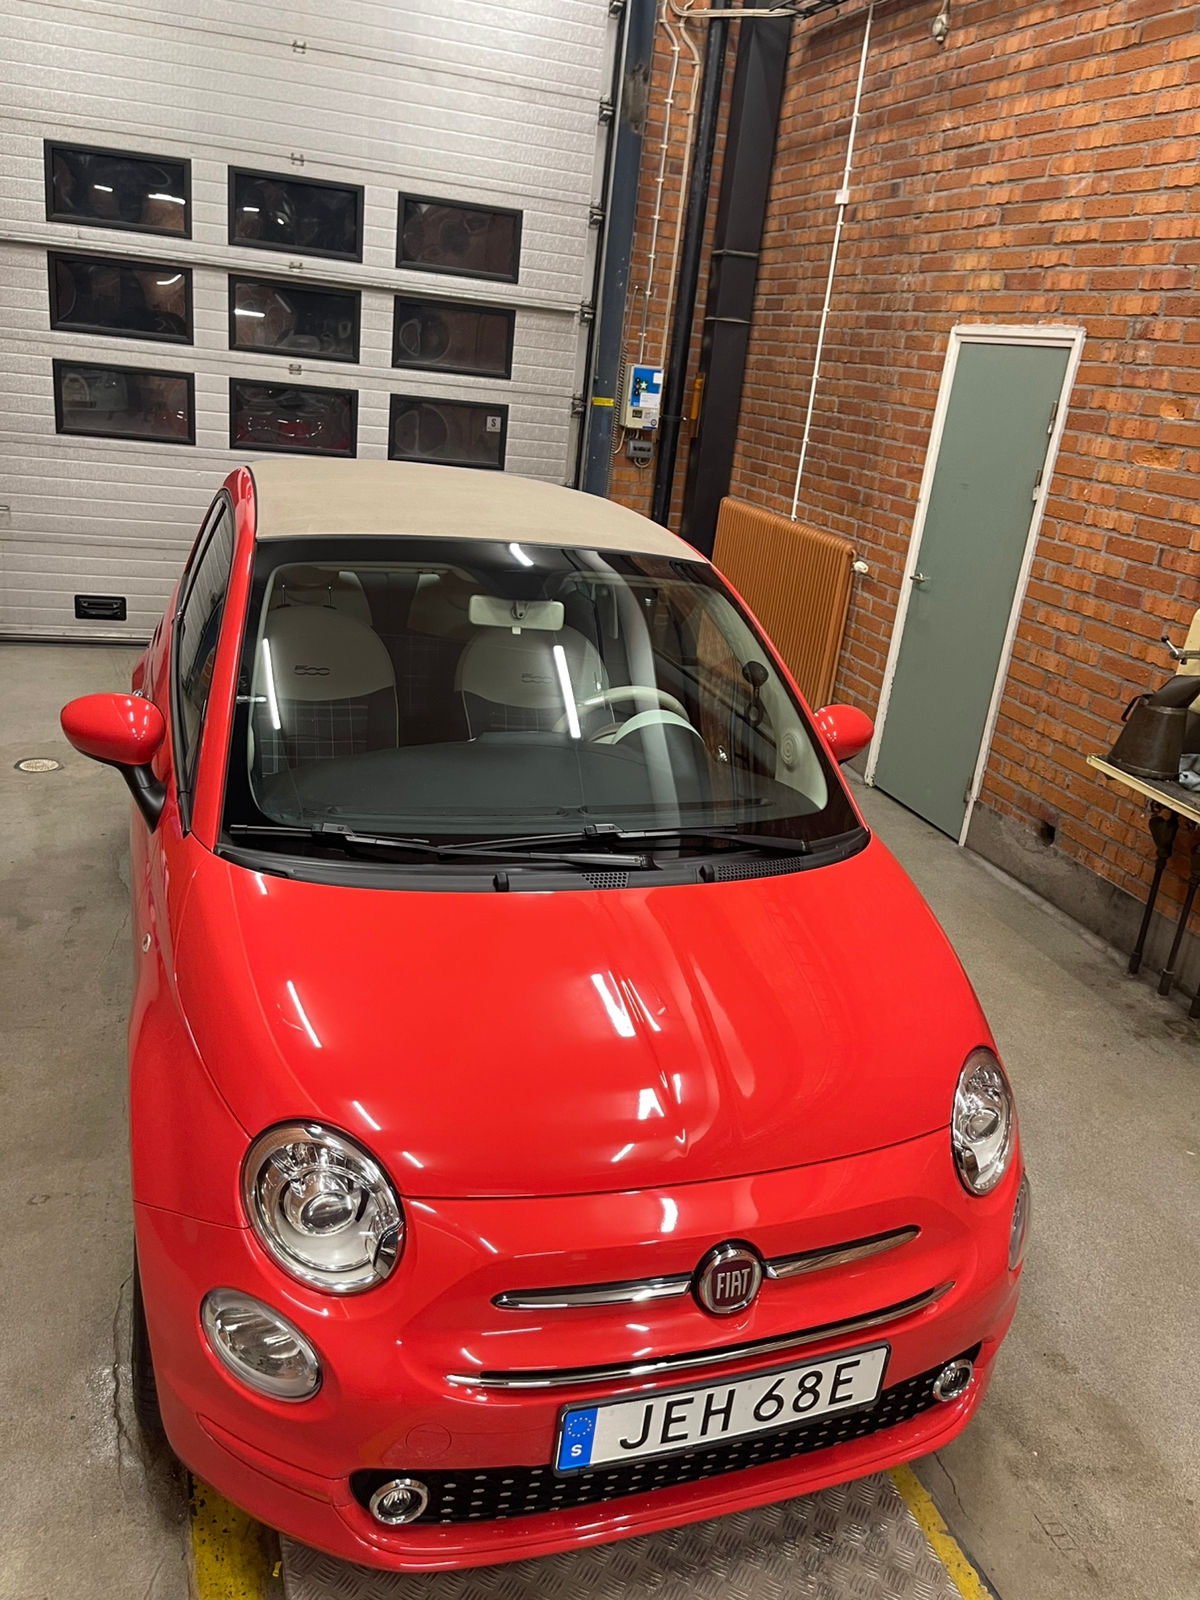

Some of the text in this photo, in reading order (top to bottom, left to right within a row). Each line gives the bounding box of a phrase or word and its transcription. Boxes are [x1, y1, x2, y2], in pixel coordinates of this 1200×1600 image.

[294, 664, 331, 676] 500
[521, 673, 554, 684] 500
[716, 1267, 751, 1300] FIAT
[619, 1359, 861, 1450] JEH 68E
[570, 1443, 583, 1457] S
